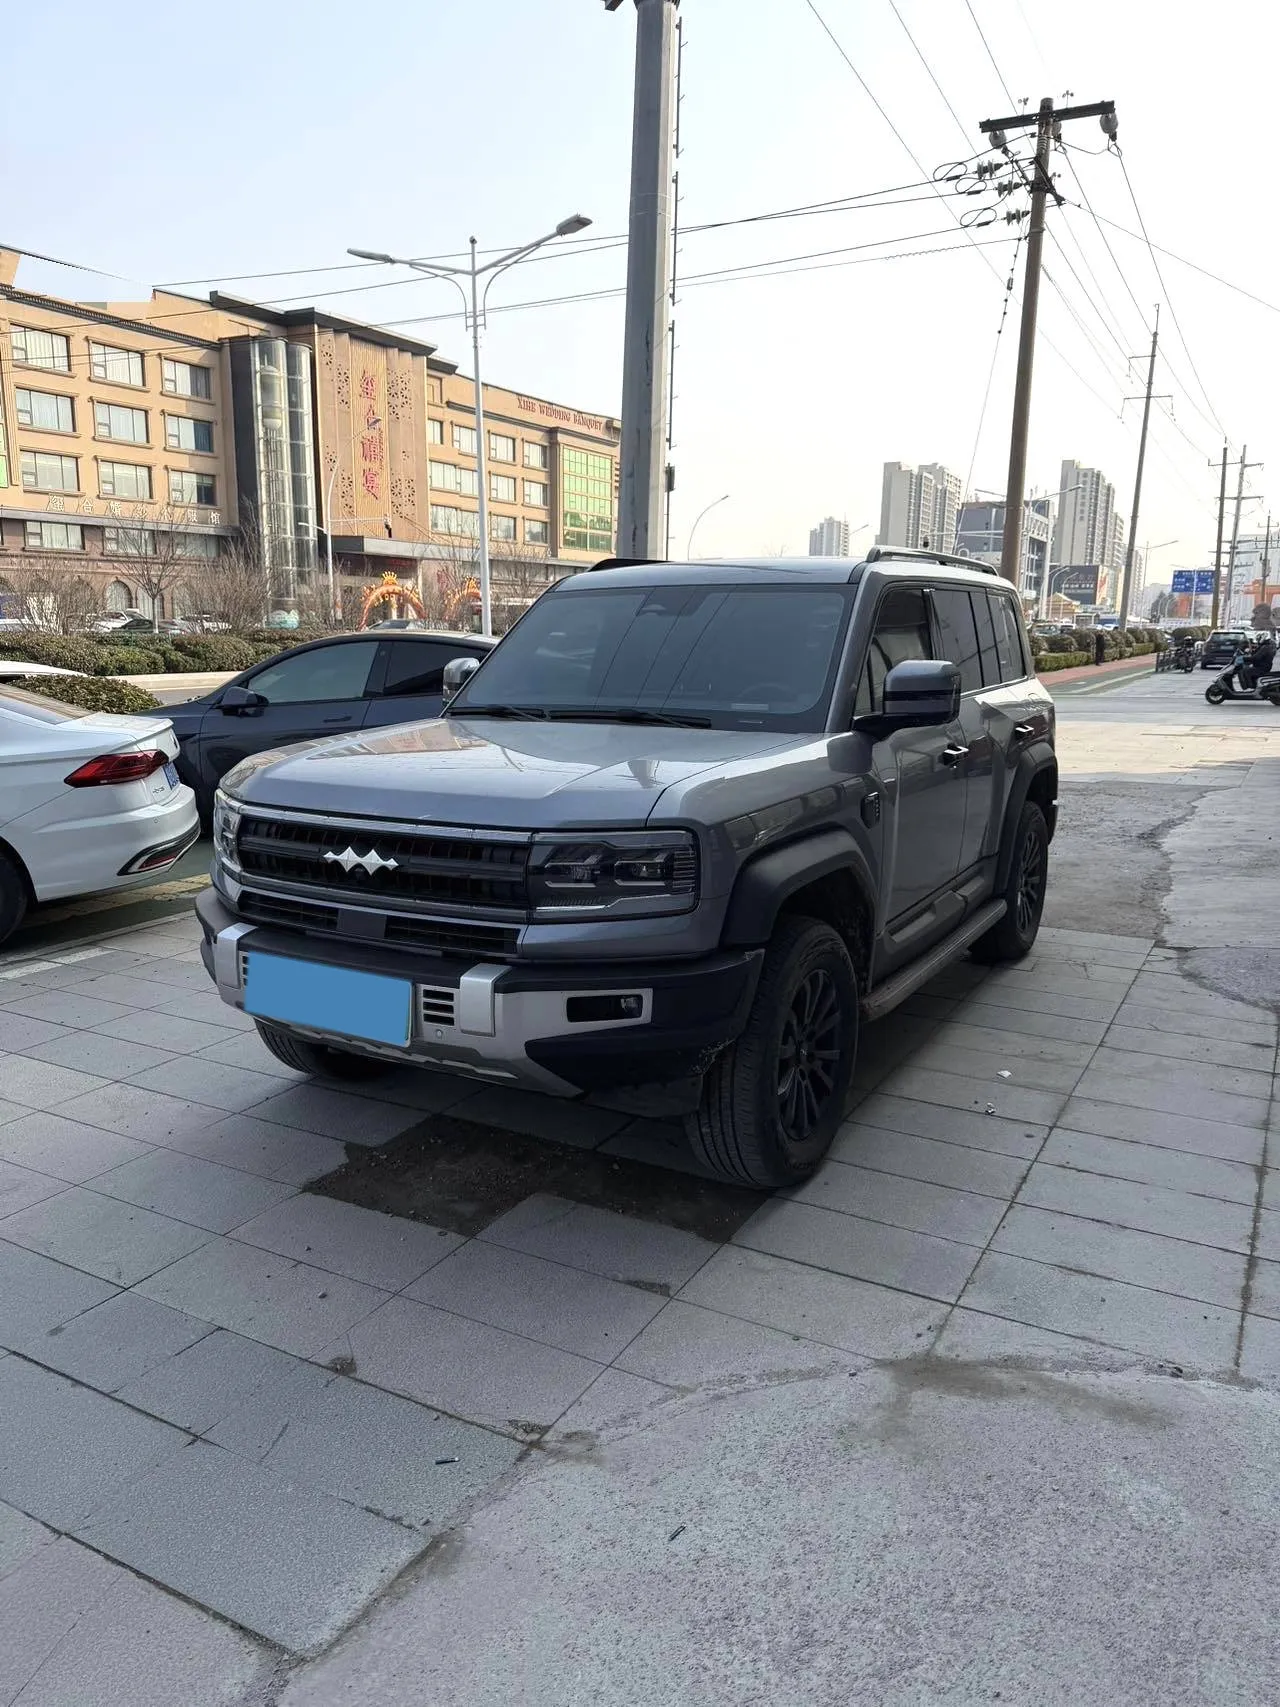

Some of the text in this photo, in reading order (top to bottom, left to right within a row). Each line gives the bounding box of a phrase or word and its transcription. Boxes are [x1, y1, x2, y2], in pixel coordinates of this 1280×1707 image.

[518, 397, 602, 431] XIHE WEDDING BANQUET
